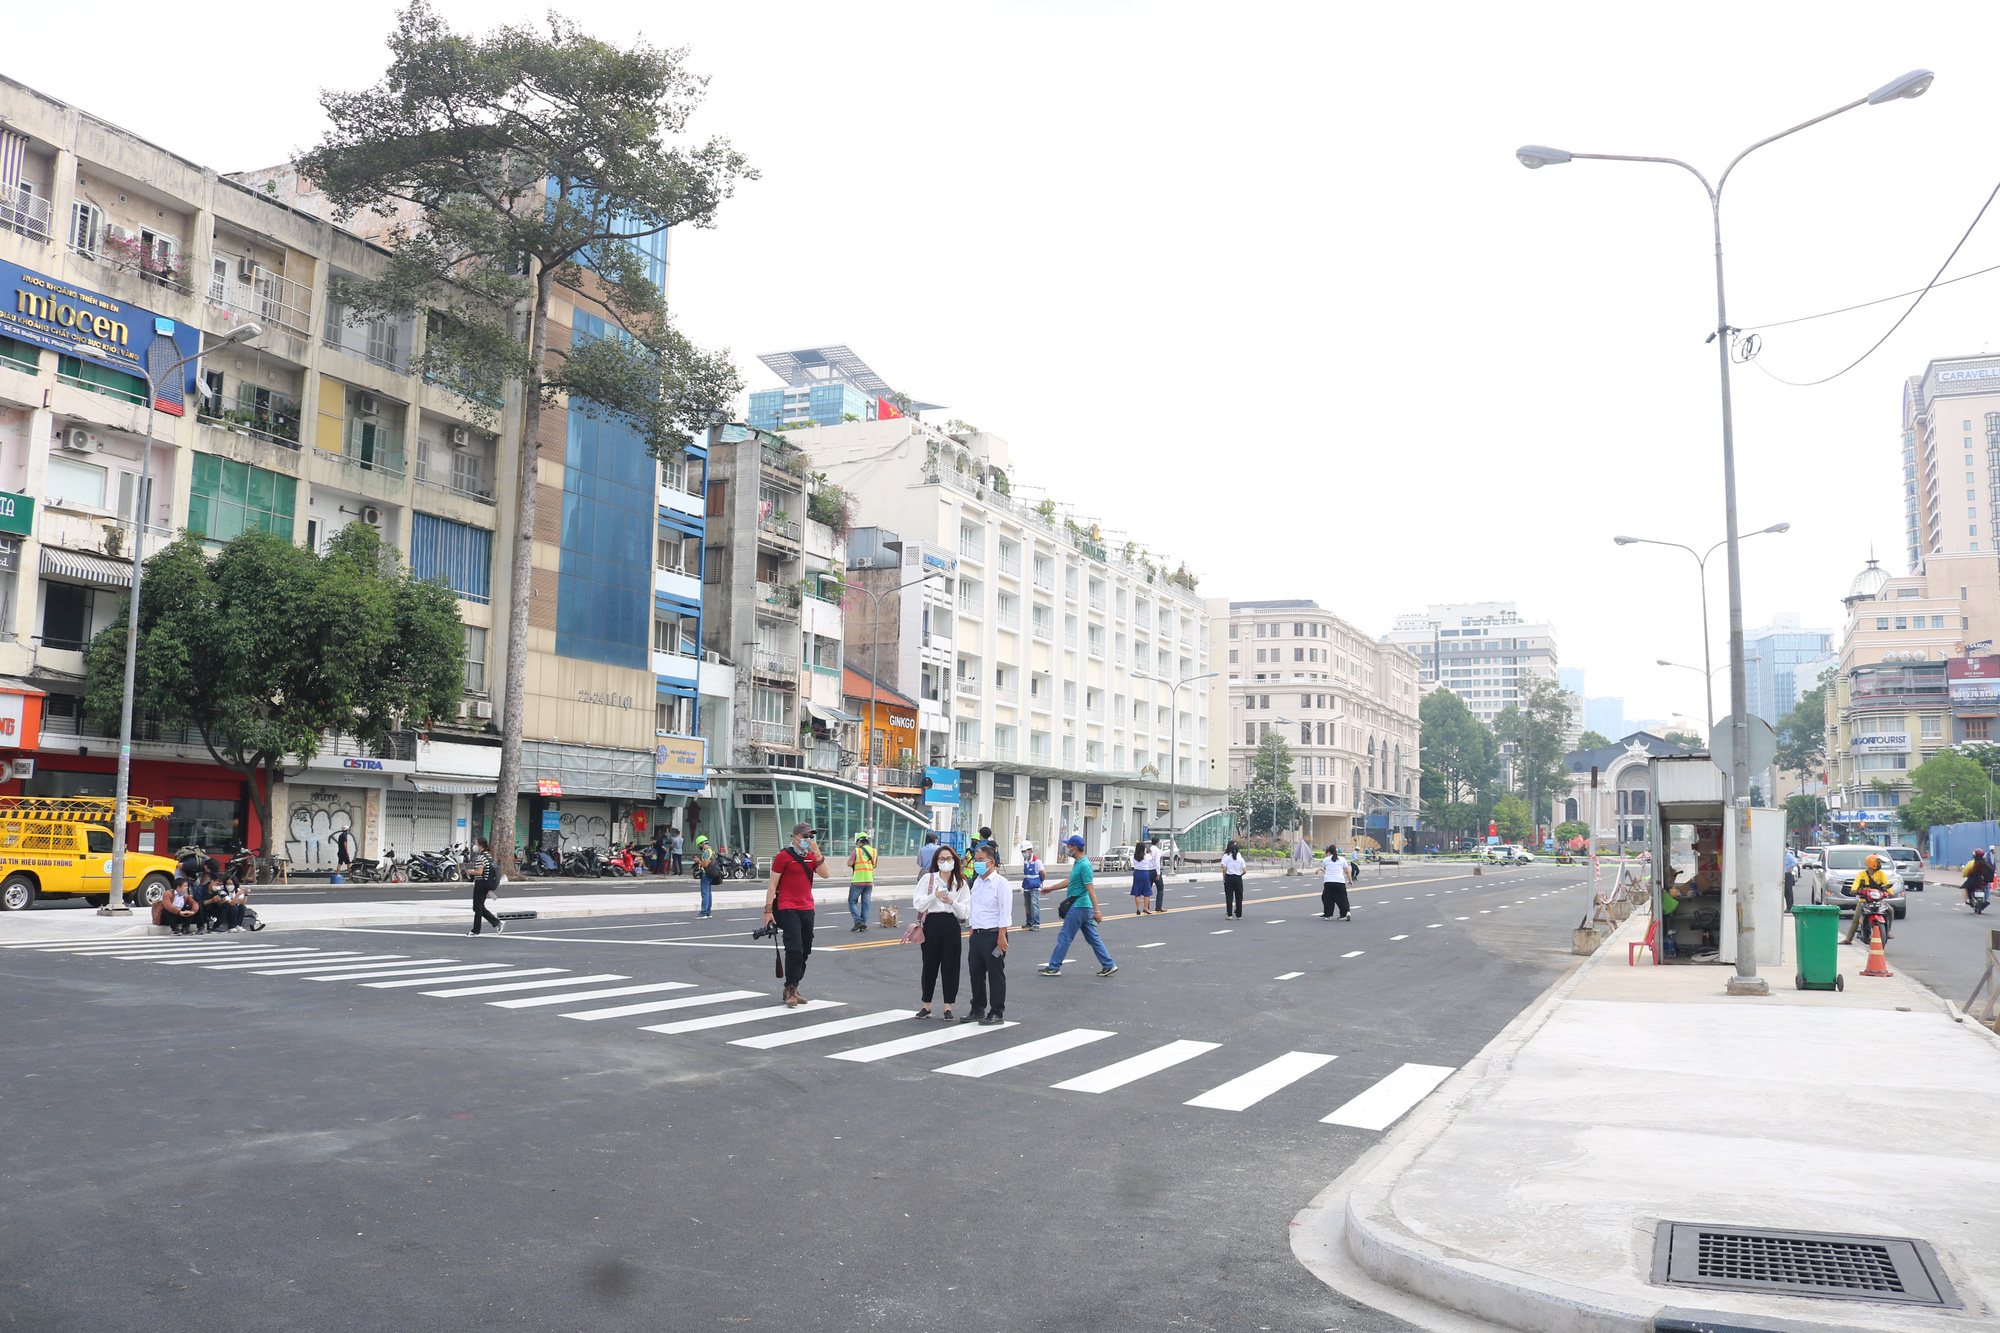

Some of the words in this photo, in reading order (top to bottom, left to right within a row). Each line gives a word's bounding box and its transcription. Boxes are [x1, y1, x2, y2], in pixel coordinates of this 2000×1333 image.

[46, 282, 78, 298] KHOÁNG
[79, 293, 98, 305] THIÊN
[16, 289, 129, 346] miocen
[18, 316, 49, 331] KHOÁNG
[50, 326, 69, 338] CHẤT
[71, 333, 87, 344] CHO
[120, 348, 140, 361] VÀNG
[1942, 368, 2000, 381] CARAVELL
[578, 689, 605, 705] 22-24
[606, 690, 617, 706] LÊ
[889, 715, 915, 729] GINKGO
[343, 758, 383, 770] CISTRA
[8, 857, 18, 865] TÍN
[53, 859, 73, 867] THÔNG
